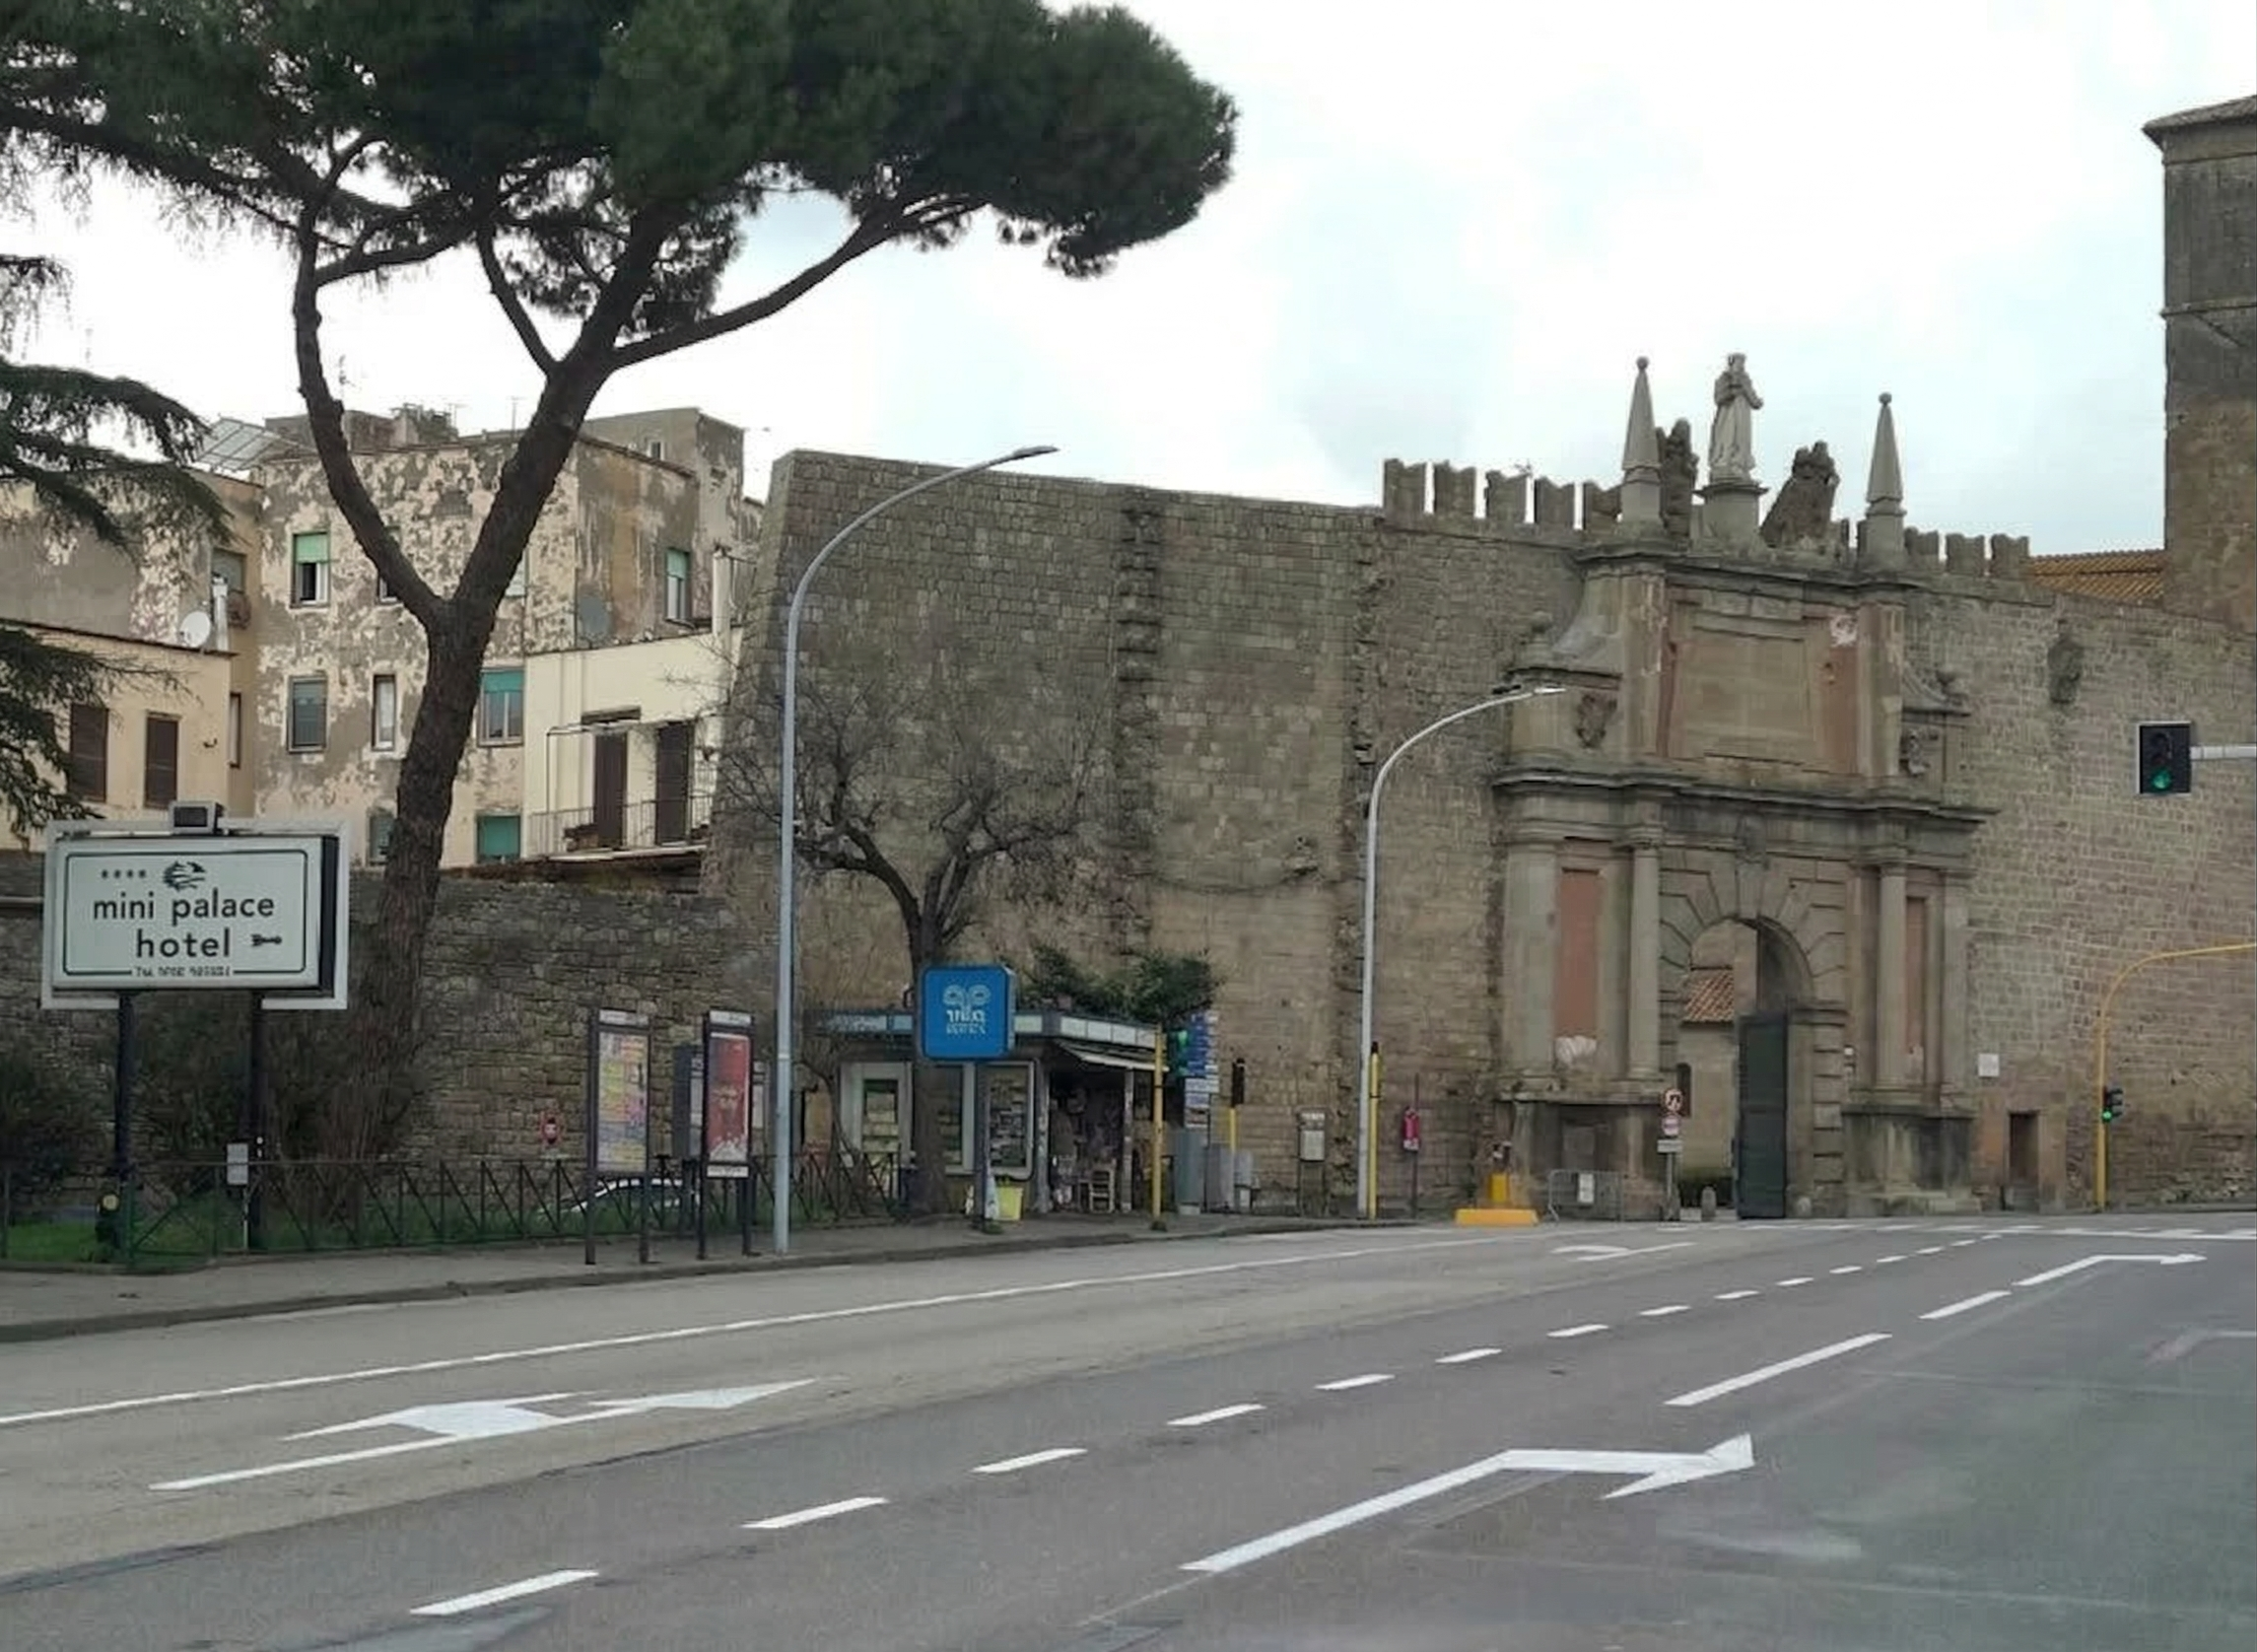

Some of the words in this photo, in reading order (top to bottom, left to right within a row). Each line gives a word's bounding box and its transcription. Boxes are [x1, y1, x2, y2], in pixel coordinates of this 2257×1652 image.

[94, 891, 155, 921] mini
[171, 888, 275, 927] palace
[136, 928, 231, 958] hotel
